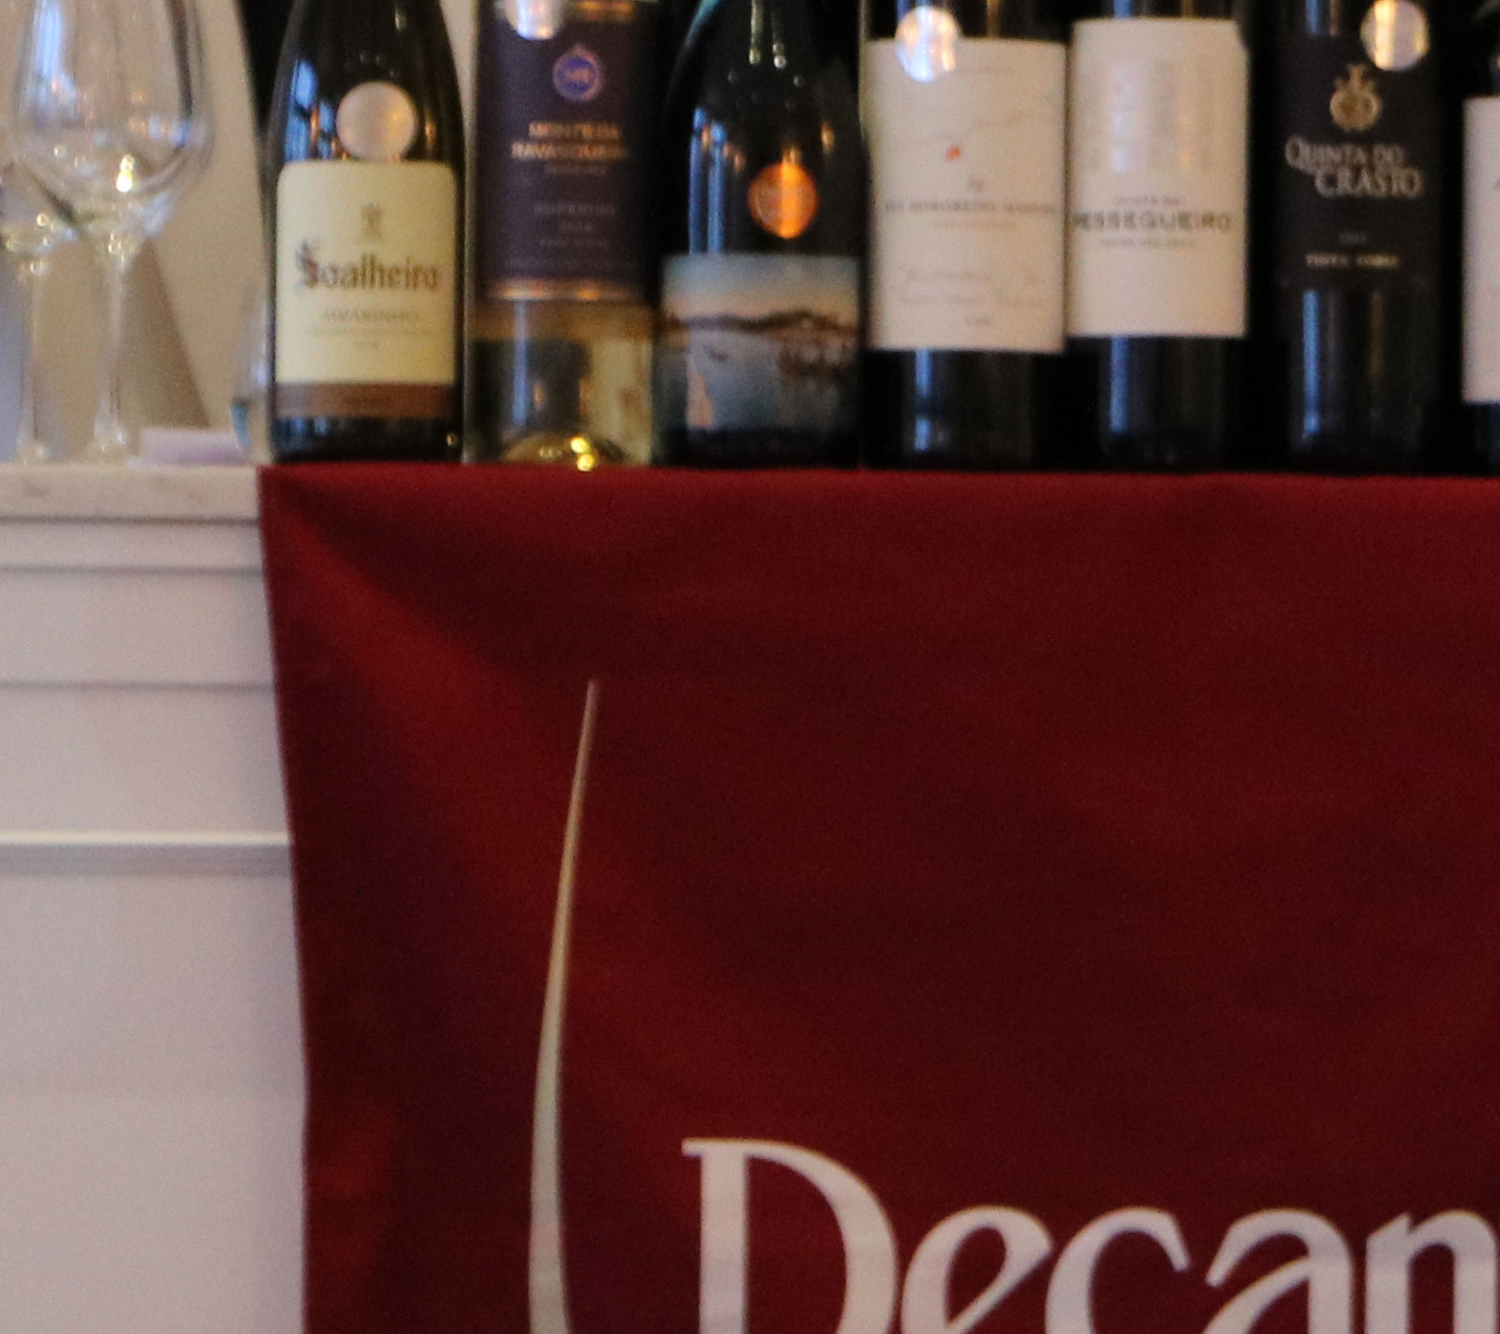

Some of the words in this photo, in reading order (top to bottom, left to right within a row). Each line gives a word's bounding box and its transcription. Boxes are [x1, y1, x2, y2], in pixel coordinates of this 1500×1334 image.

[1284, 135, 1369, 174] QUINTA
[1372, 143, 1406, 167] DO
[1313, 165, 1426, 200] CRASTO
[295, 238, 440, 291] Soalheiro
